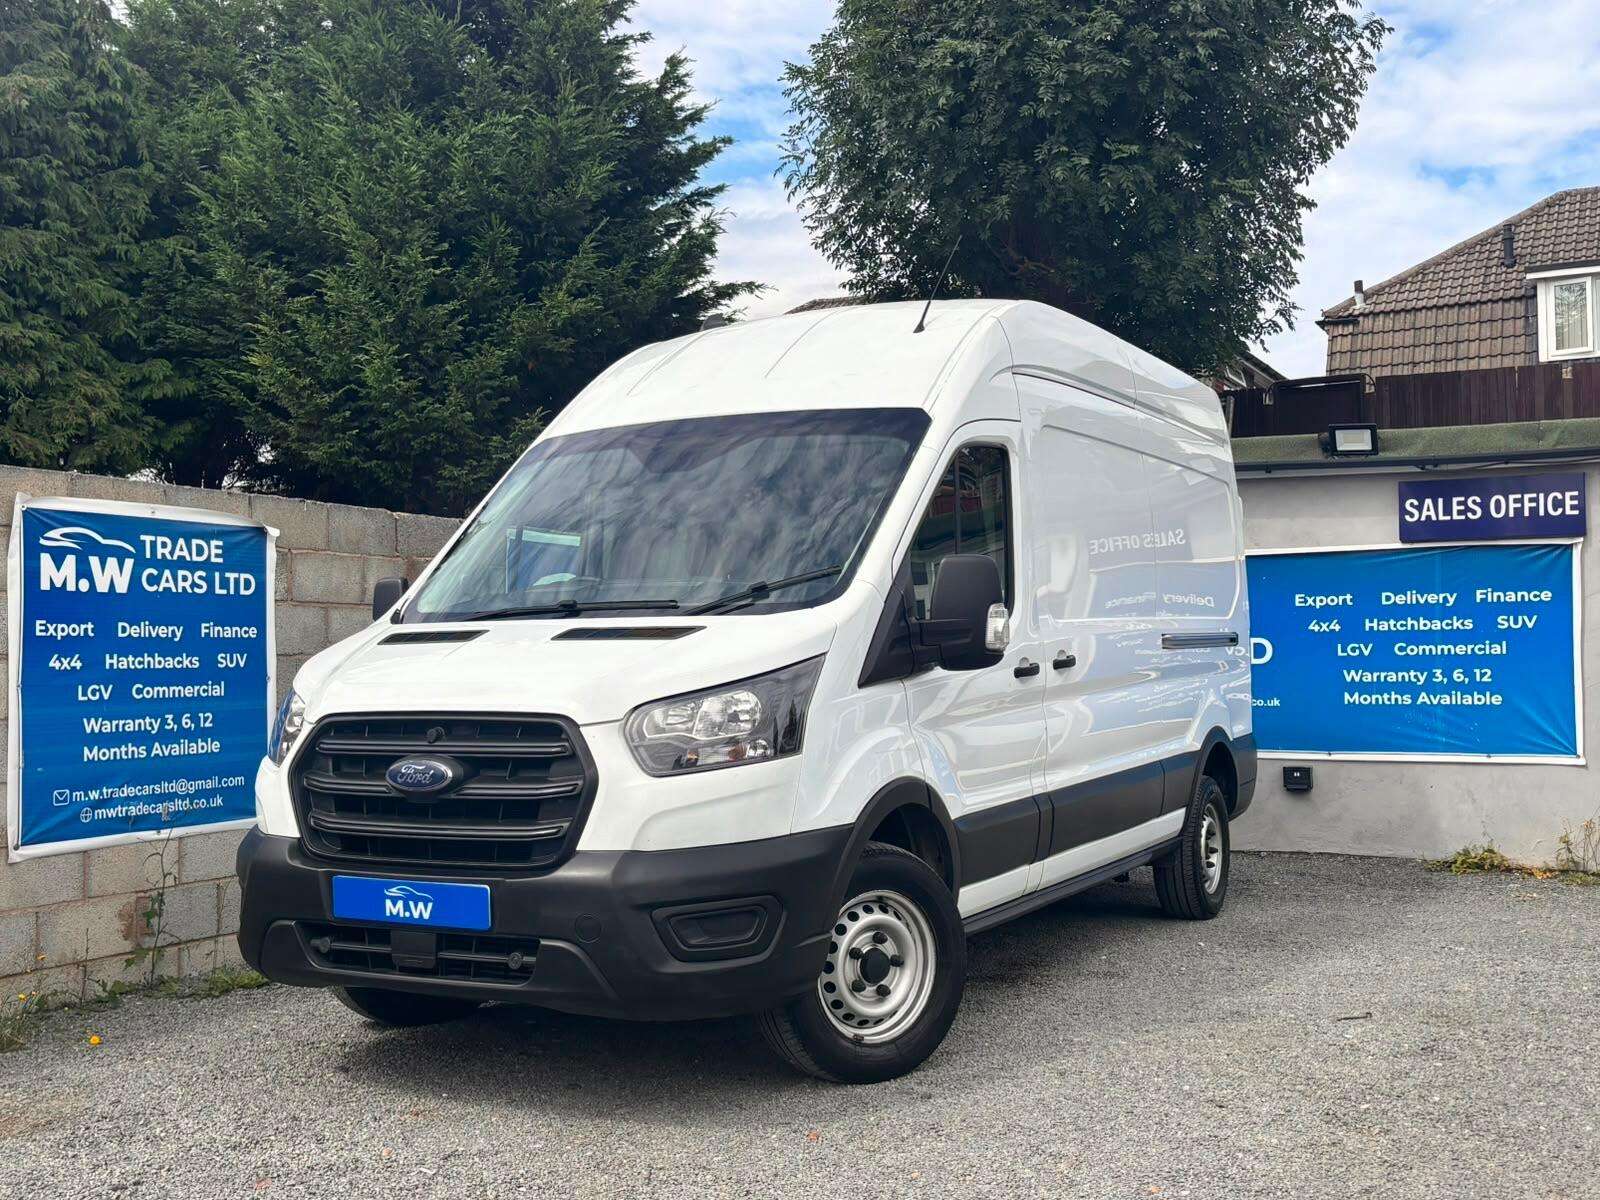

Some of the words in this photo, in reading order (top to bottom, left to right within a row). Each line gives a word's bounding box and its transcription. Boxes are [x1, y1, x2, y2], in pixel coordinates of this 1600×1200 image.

[1404, 495, 1482, 522] SALES
[1489, 491, 1580, 517] OFFICE
[140, 535, 224, 563] TRADE
[40, 552, 135, 594] M.W
[141, 568, 208, 595] CARS
[214, 571, 256, 595] LTD
[1295, 593, 1354, 609] Export
[1381, 591, 1458, 607] Delivery
[1475, 588, 1553, 603] Finance
[35, 620, 95, 638] Export
[117, 621, 184, 641] Delivery
[200, 622, 258, 639] Finance
[1308, 619, 1342, 633] 4x4
[1364, 616, 1474, 631] Hatchbacks
[1496, 614, 1538, 629] SUV
[1336, 643, 1374, 657] LGV
[1393, 640, 1508, 656] Commercial
[48, 654, 83, 671] 4x4
[105, 653, 200, 670] Hatchbacks
[217, 652, 248, 668] SUV
[1343, 668, 1428, 685] Warranty
[1431, 669, 1449, 684] 3,
[1452, 669, 1470, 684] 6,
[1473, 668, 1493, 683] 12
[77, 684, 113, 701] LGV
[131, 681, 226, 699] Commercial
[1343, 691, 1413, 706] Months
[1416, 691, 1503, 706] Available
[83, 716, 161, 735] Warranty
[164, 715, 179, 732] 3,
[181, 714, 196, 731] 6,
[198, 712, 214, 728] 12
[83, 743, 147, 762] Months
[151, 738, 221, 758] Available
[396, 764, 435, 784] Ford
[72, 775, 246, 802] m.w.tradecarsltd@gmail.com
[384, 897, 434, 920] M.W
